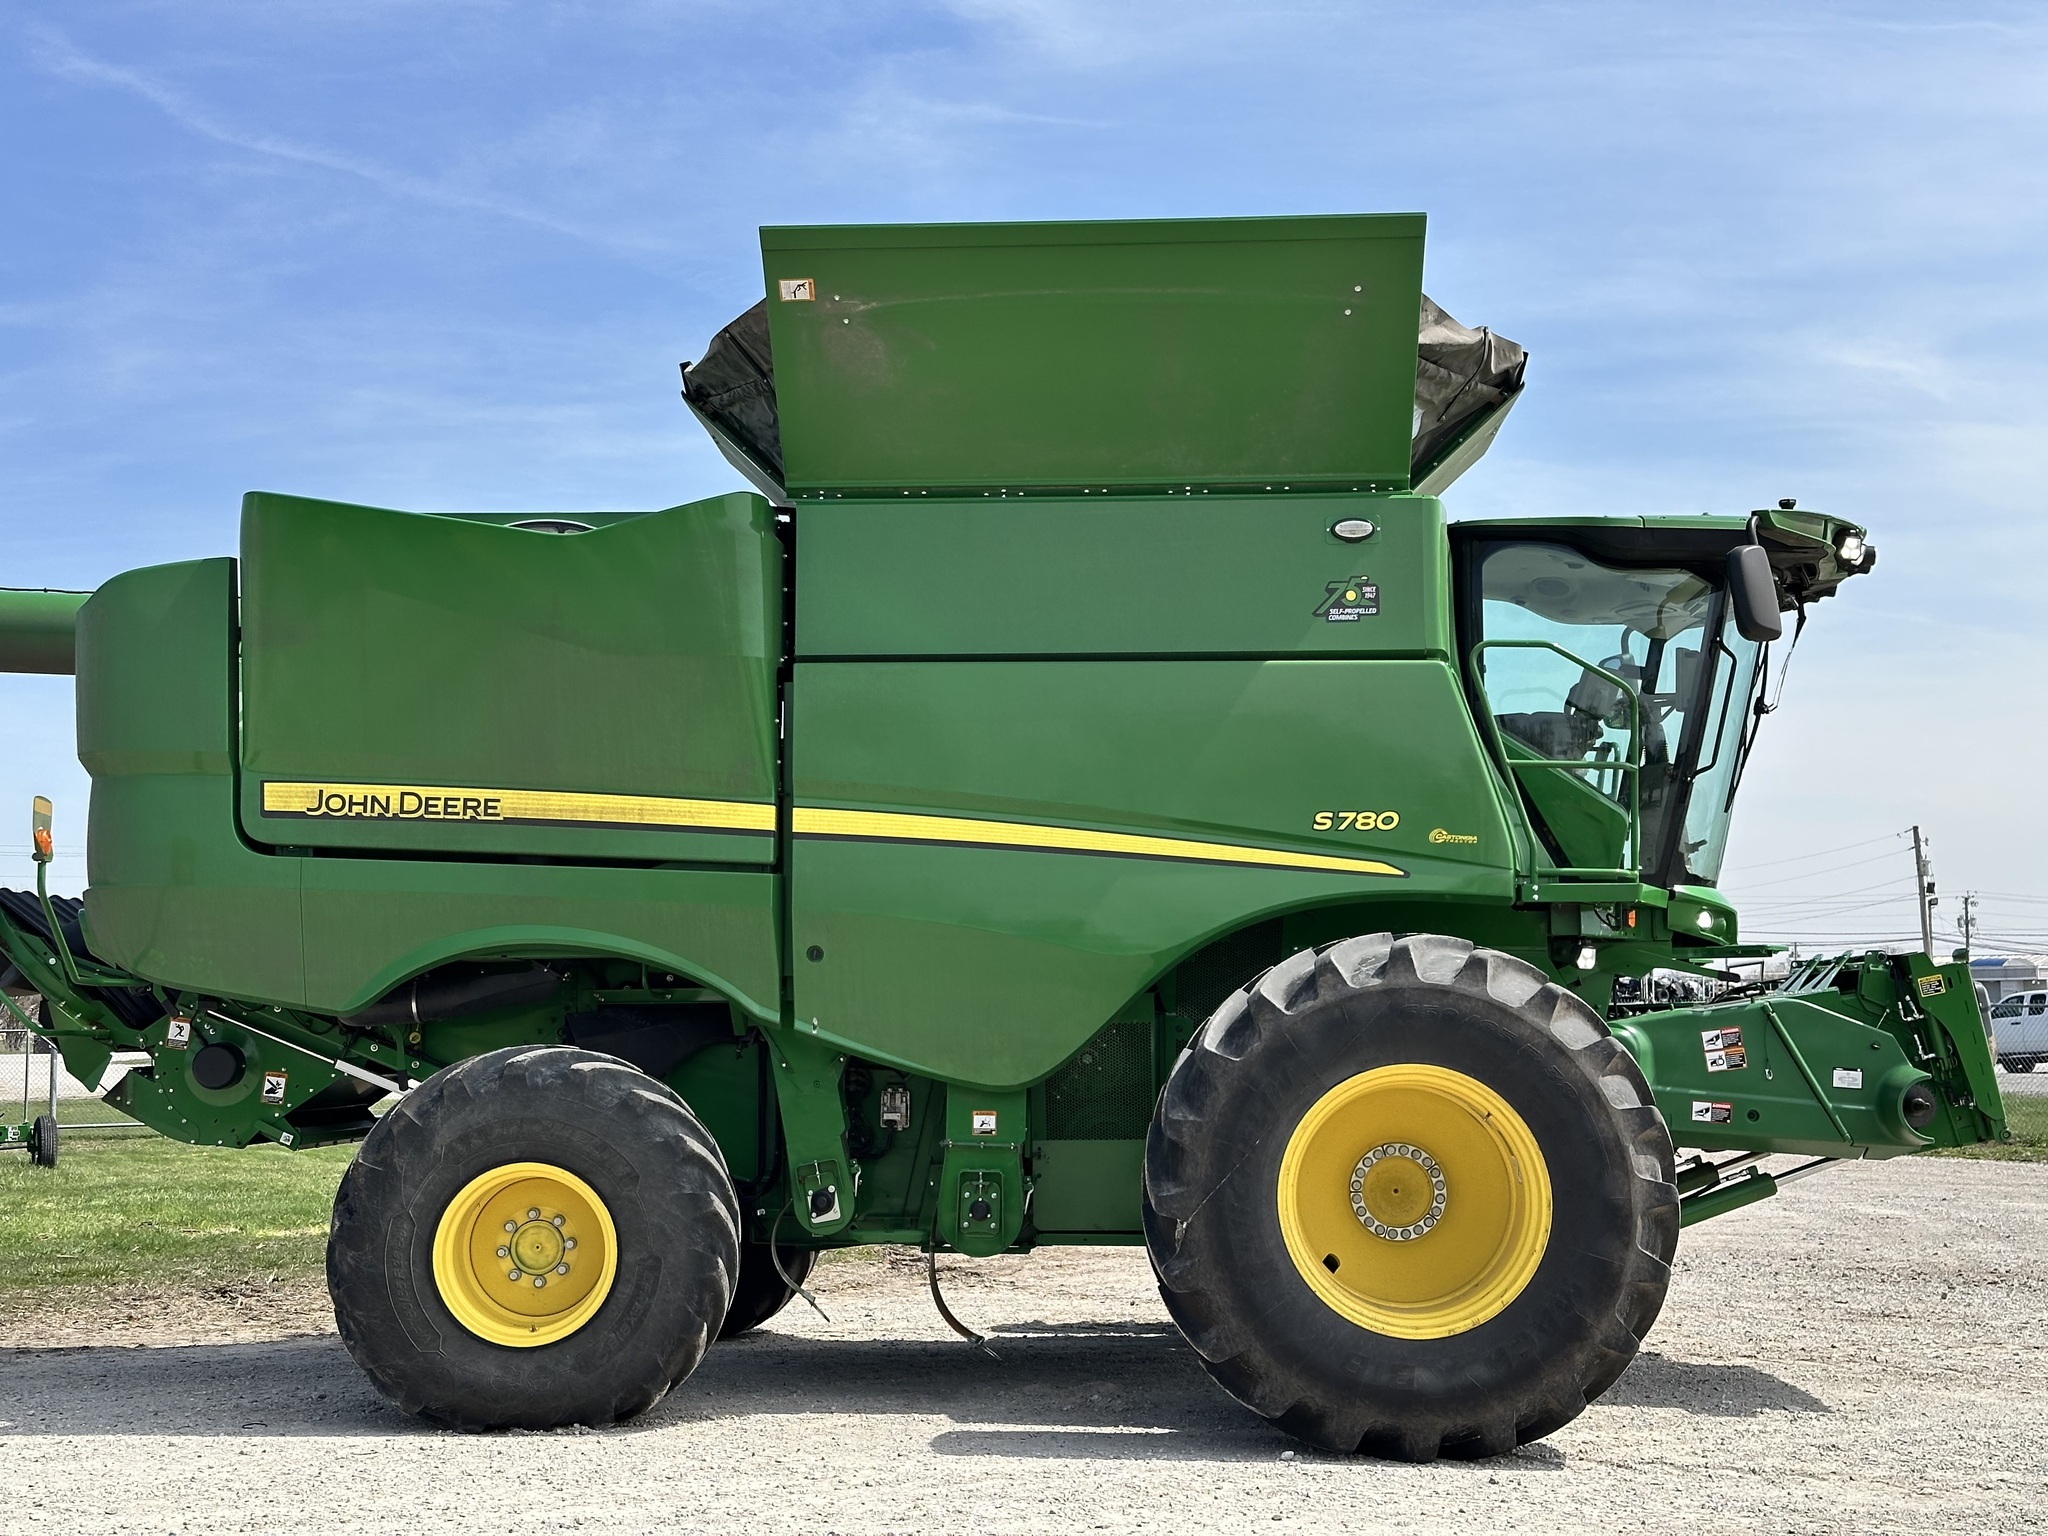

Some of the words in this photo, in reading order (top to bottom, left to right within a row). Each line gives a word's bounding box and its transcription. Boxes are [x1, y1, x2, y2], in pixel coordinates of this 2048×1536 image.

[1329, 607, 1377, 615] SELF-PROPELLED
[305, 789, 392, 816] JOHN
[399, 791, 502, 819] DEERE
